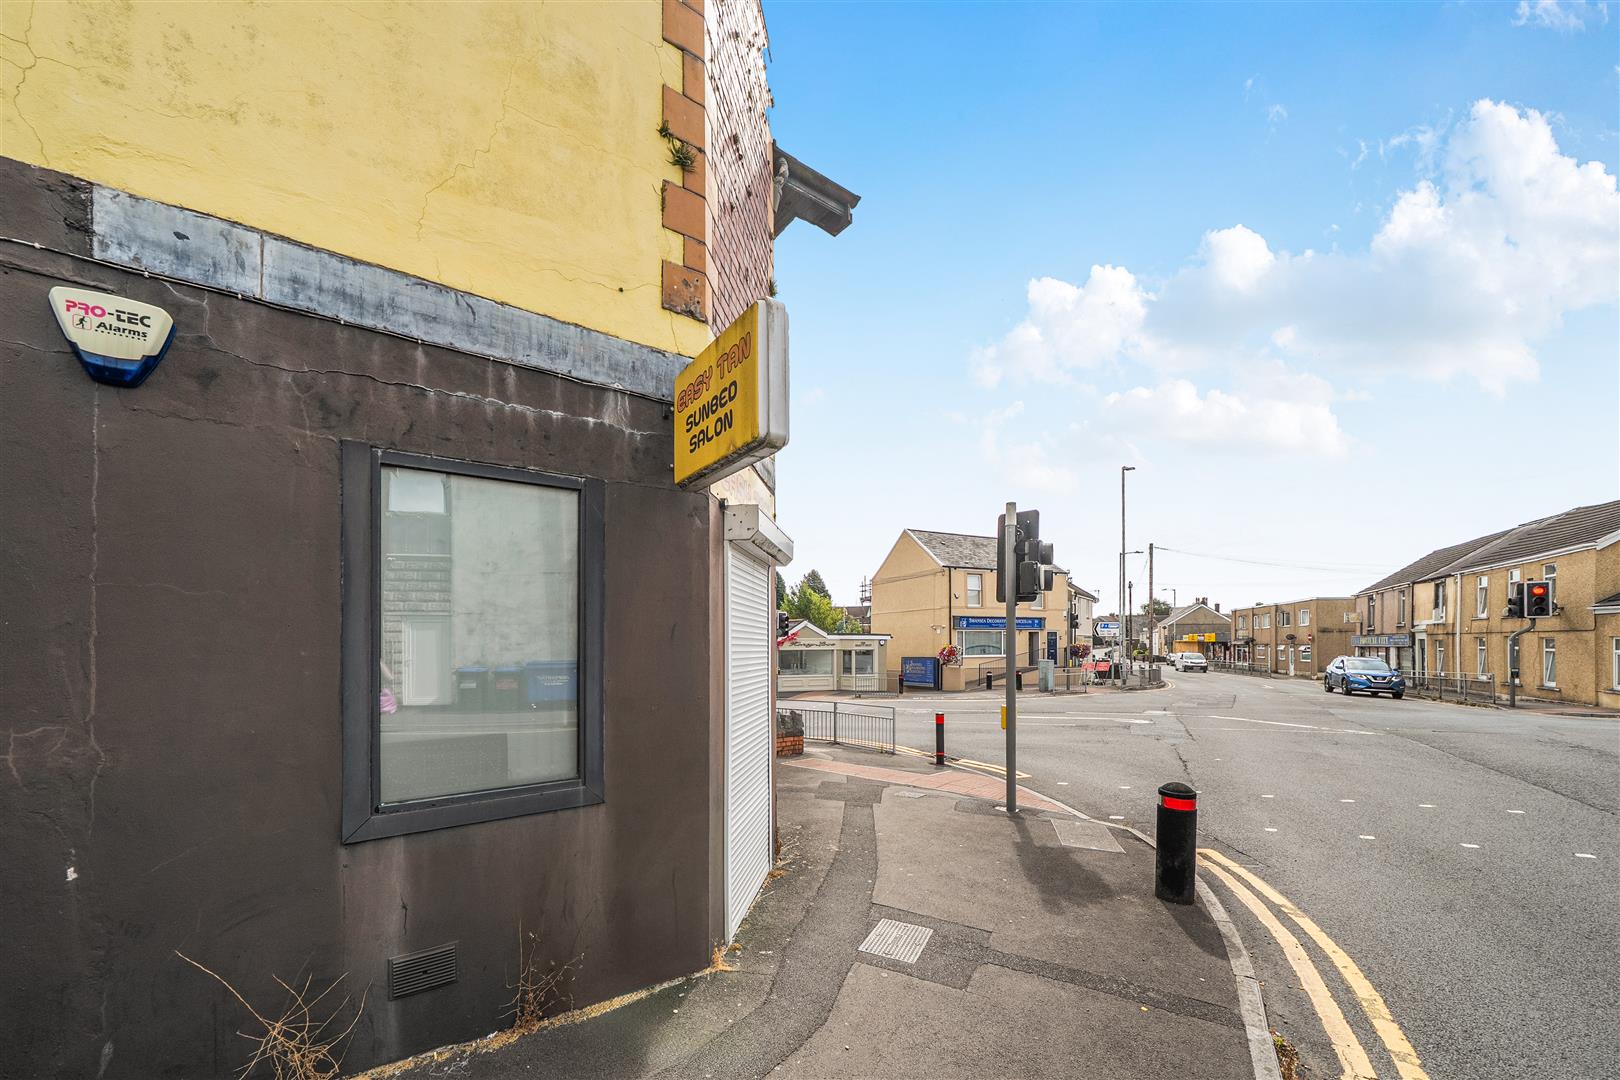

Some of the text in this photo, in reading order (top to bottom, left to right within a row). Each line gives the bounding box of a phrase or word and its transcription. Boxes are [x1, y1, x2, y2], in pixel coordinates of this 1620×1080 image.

[65, 300, 151, 328] PRO-TEC
[96, 322, 147, 338] Alarms
[677, 331, 752, 413] EASY TAN
[686, 380, 737, 433] SUNBED
[689, 408, 733, 454] SALON
